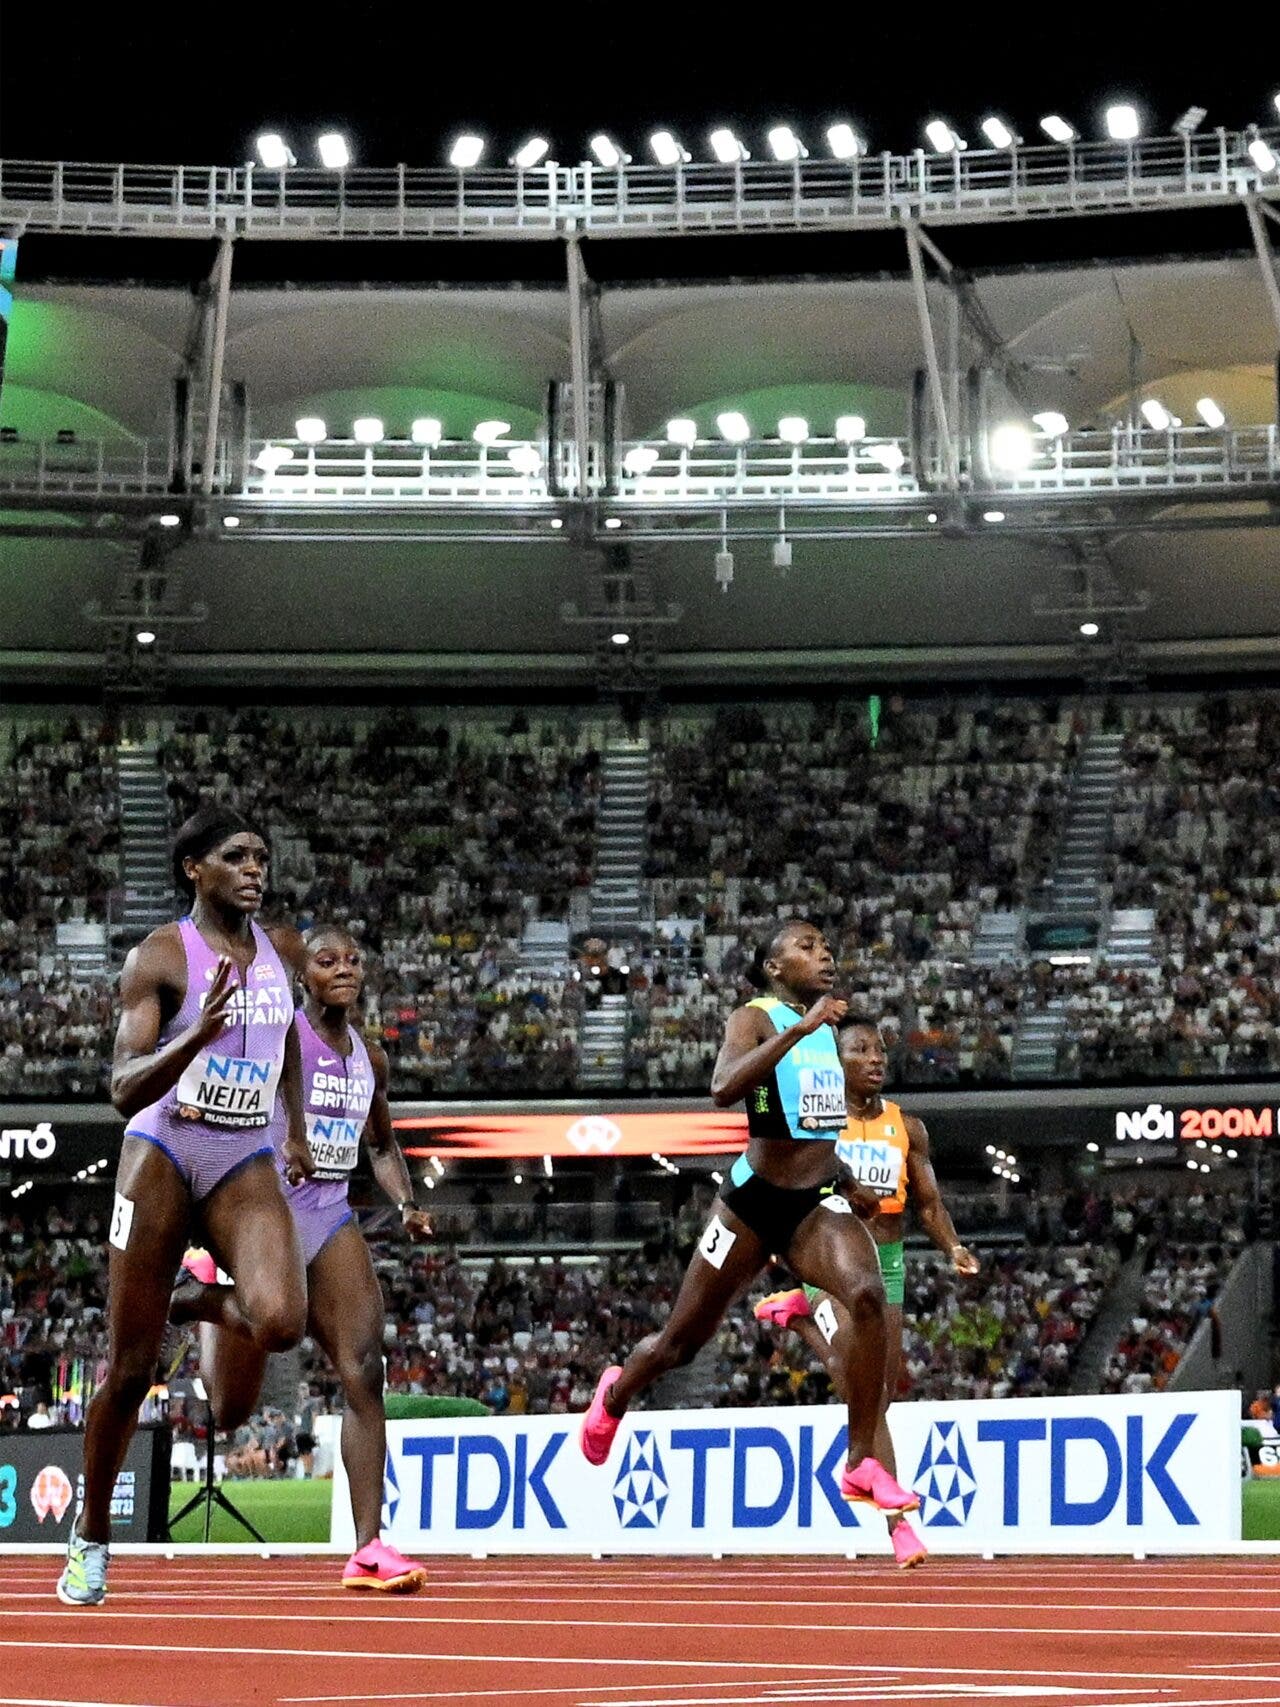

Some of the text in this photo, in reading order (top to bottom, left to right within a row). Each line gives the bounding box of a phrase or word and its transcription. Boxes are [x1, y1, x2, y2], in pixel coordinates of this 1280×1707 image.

[206, 1055, 270, 1084] NTN
[813, 1070, 844, 1089] NTN
[196, 1081, 261, 1110] NEITA
[313, 1072, 369, 1095] GREAT
[310, 1089, 369, 1111] BRITAIN
[312, 1118, 358, 1141] NTN
[1180, 1108, 1273, 1139] 200M
[837, 1143, 887, 1162] NTN
[858, 1166, 891, 1184] LOU
[707, 1229, 720, 1254] 3
[402, 1432, 568, 1530] TDK
[670, 1424, 861, 1528] TDK
[977, 1413, 1200, 1526] TDK
